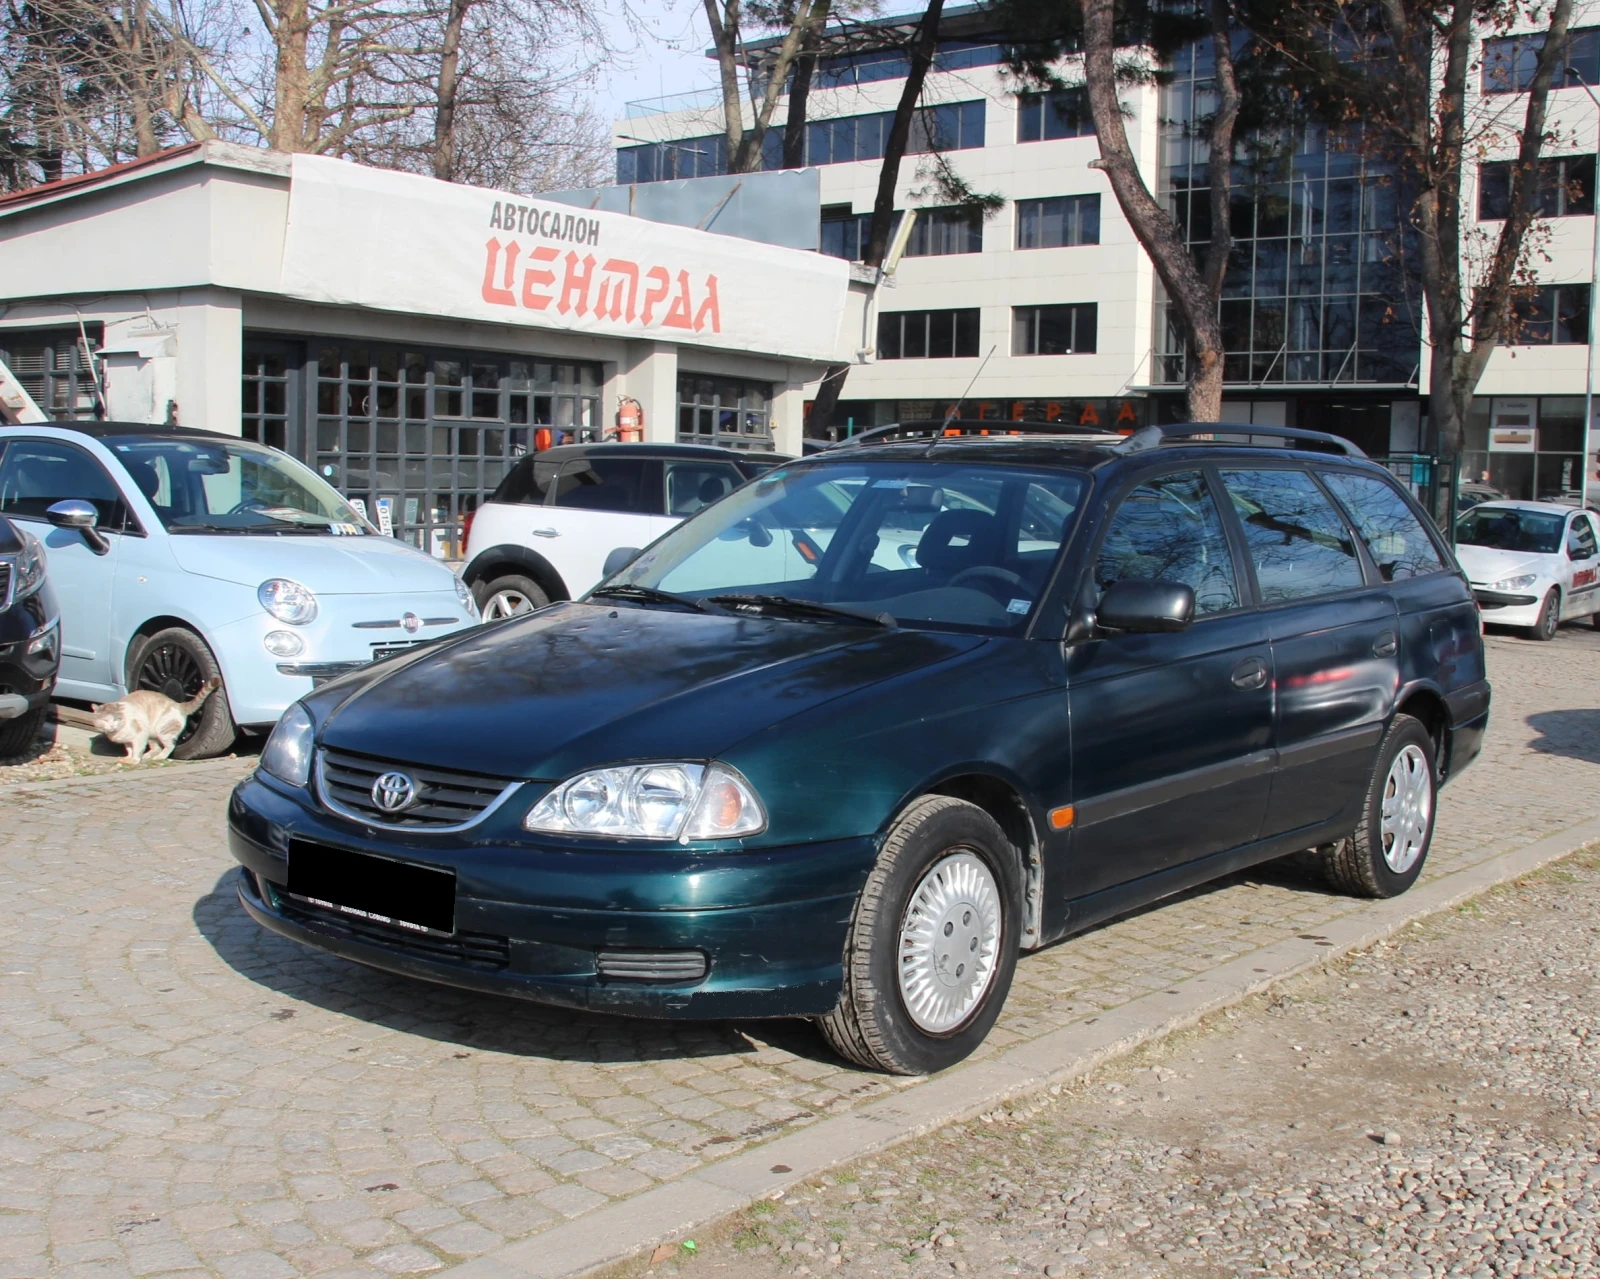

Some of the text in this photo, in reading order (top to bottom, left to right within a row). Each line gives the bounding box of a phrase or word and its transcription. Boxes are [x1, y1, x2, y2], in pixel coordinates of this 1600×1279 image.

[489, 200, 600, 247] АВТОСАЛОН
[481, 236, 721, 334] ЦЕНТРАЛ
[399, 920, 420, 930] TOYOTA
